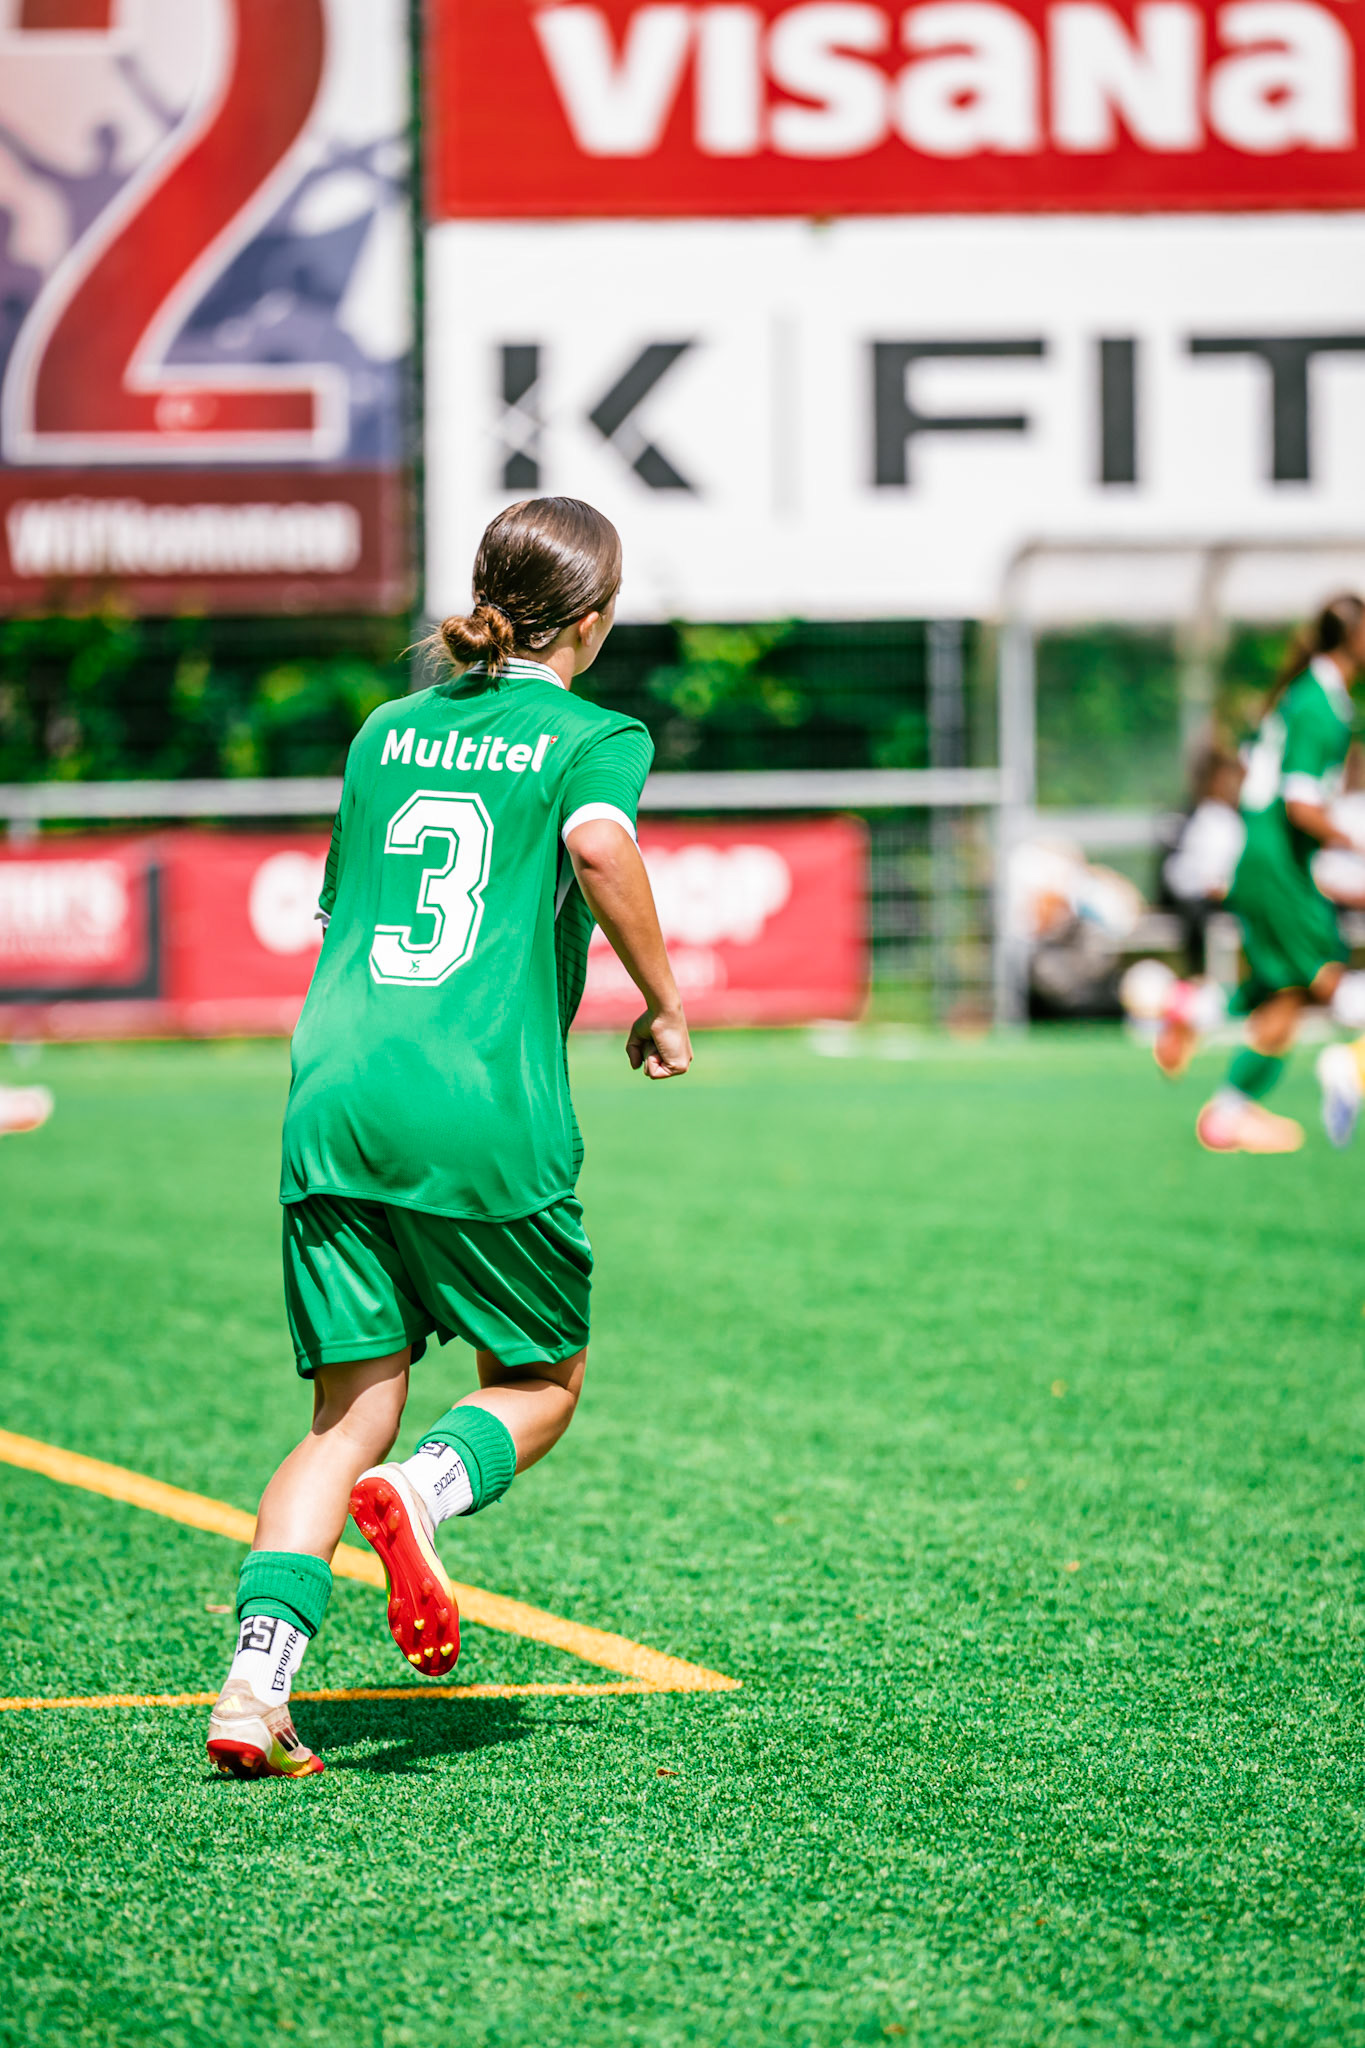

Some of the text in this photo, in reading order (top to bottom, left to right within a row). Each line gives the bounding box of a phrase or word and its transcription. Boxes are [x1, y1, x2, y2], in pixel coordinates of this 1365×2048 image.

[497, 336, 1365, 491] K FIT
[380, 728, 550, 773] Multitel
[369, 789, 494, 987] 3
